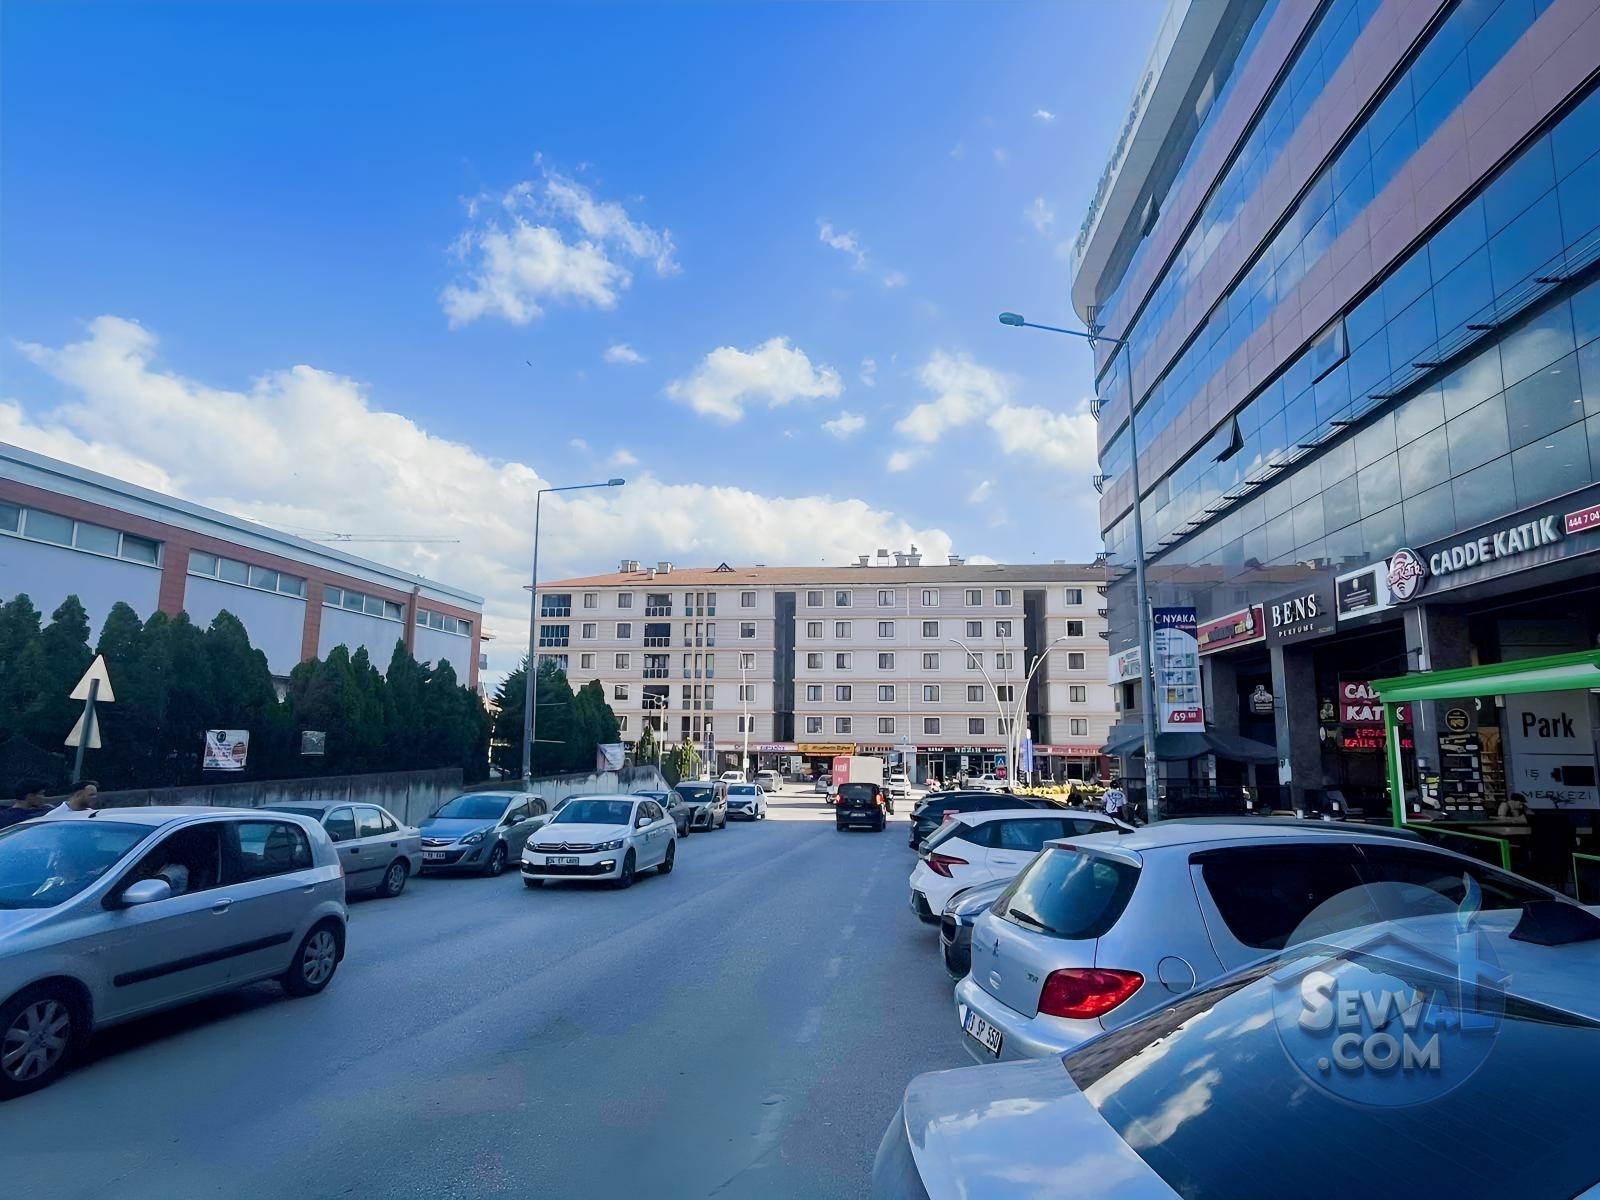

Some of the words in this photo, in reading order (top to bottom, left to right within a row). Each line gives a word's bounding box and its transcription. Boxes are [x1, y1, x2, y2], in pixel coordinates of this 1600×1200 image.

[1430, 536, 1494, 576] CADDE
[1493, 514, 1560, 559] KATIK
[1271, 593, 1317, 627] BENS
[1173, 712, 1186, 722] 69
[1346, 705, 1405, 720] KATK
[1521, 712, 1576, 738] Park
